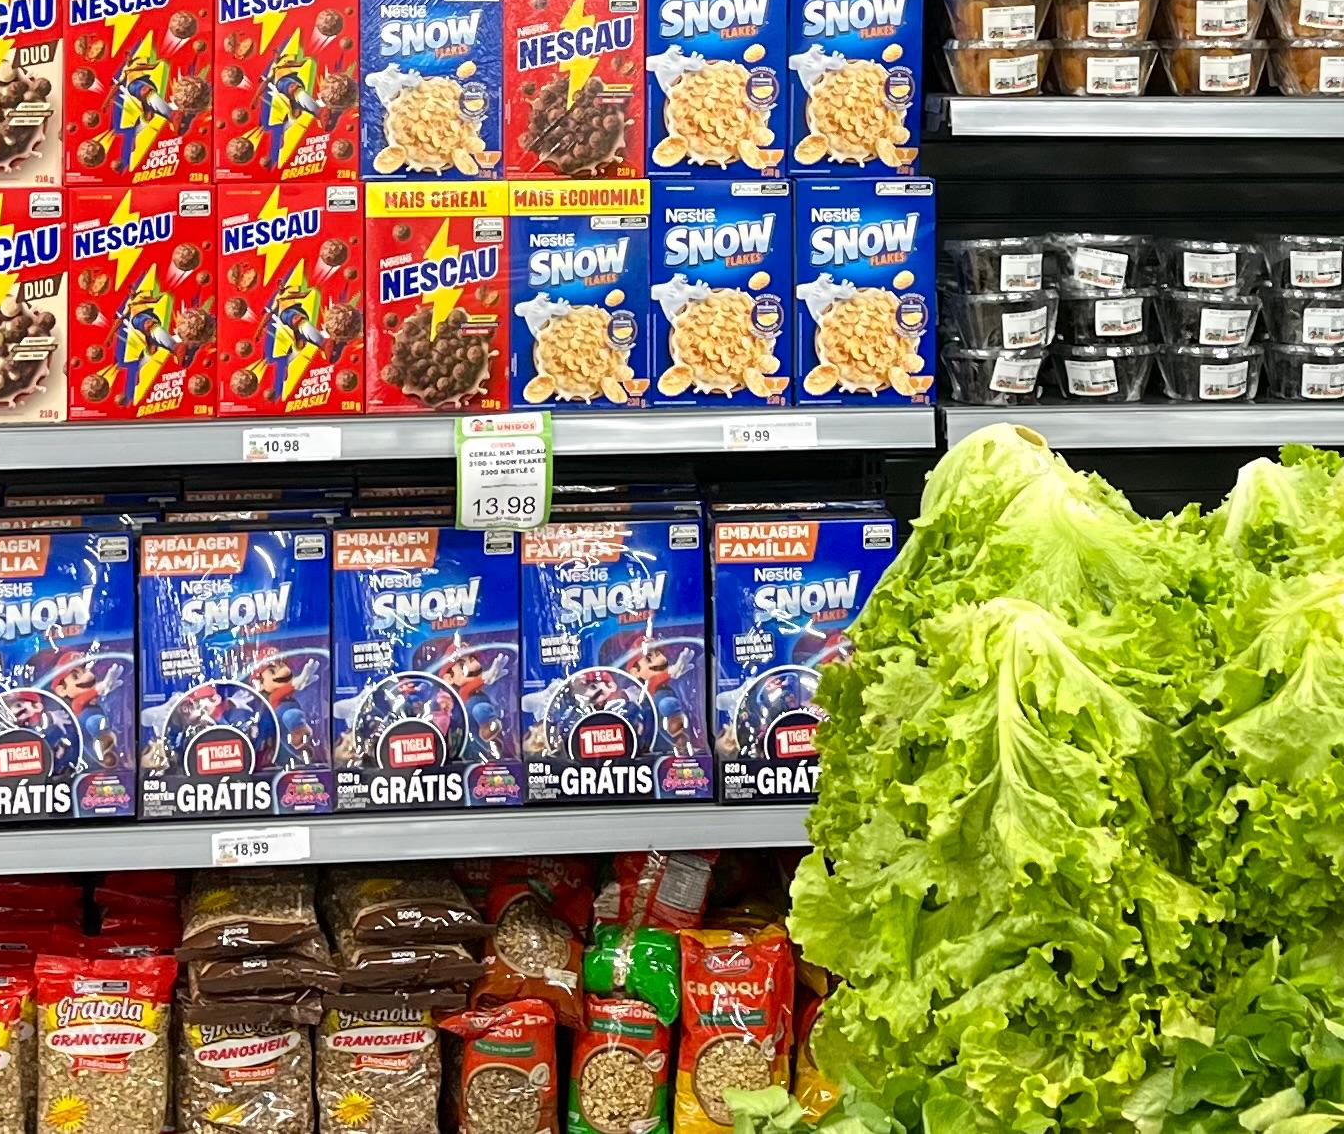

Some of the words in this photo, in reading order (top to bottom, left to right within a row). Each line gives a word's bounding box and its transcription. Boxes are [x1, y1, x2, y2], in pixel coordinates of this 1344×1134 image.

[720, 24, 757, 39] FLAKES
[860, 25, 895, 39] FLAKES
[517, 18, 634, 71] NESCAU
[132, 160, 179, 183] BRASIL!
[384, 191, 424, 209] MAIS
[431, 190, 487, 207] CEREAL
[513, 189, 552, 207] MAIS
[557, 188, 645, 206] ECONOMIA!
[811, 207, 860, 222] Nestlé
[664, 213, 776, 266] SNOW
[528, 238, 629, 288] SNOW
[724, 252, 763, 267] FLAKES
[380, 246, 499, 302] NESCAU
[23, 278, 54, 299] DUO
[497, 423, 536, 431] UNIDOS
[742, 429, 770, 443] 9,99
[263, 439, 300, 454] 10,98
[472, 496, 536, 516] 13,98
[337, 532, 429, 550] EMBALAGEM
[719, 526, 810, 543] EMBALAGEM
[337, 544, 427, 565] FAMÍLIA
[719, 540, 807, 558] FAMÍLIA
[560, 567, 608, 581] Nestlé
[754, 568, 802, 581] Nestlé
[373, 576, 480, 630] SNOW
[560, 571, 668, 623] SNOW
[755, 571, 860, 621] SNOW
[617, 609, 653, 624] FLAKES
[811, 609, 847, 622] FLAKES
[593, 728, 622, 744] TIGELA
[8, 746, 40, 761] TIGELA
[560, 762, 653, 796] GRÁTIS
[370, 772, 462, 805] GRÁTIS
[233, 842, 268, 856] 18,99
[686, 979, 774, 996] GRANOLA
[57, 999, 142, 1025] Granola
[51, 1032, 146, 1048] GRANOSHEIK
[333, 1032, 426, 1048] GRANOSHEIK
[198, 1036, 291, 1062] GRANOSHEIK
